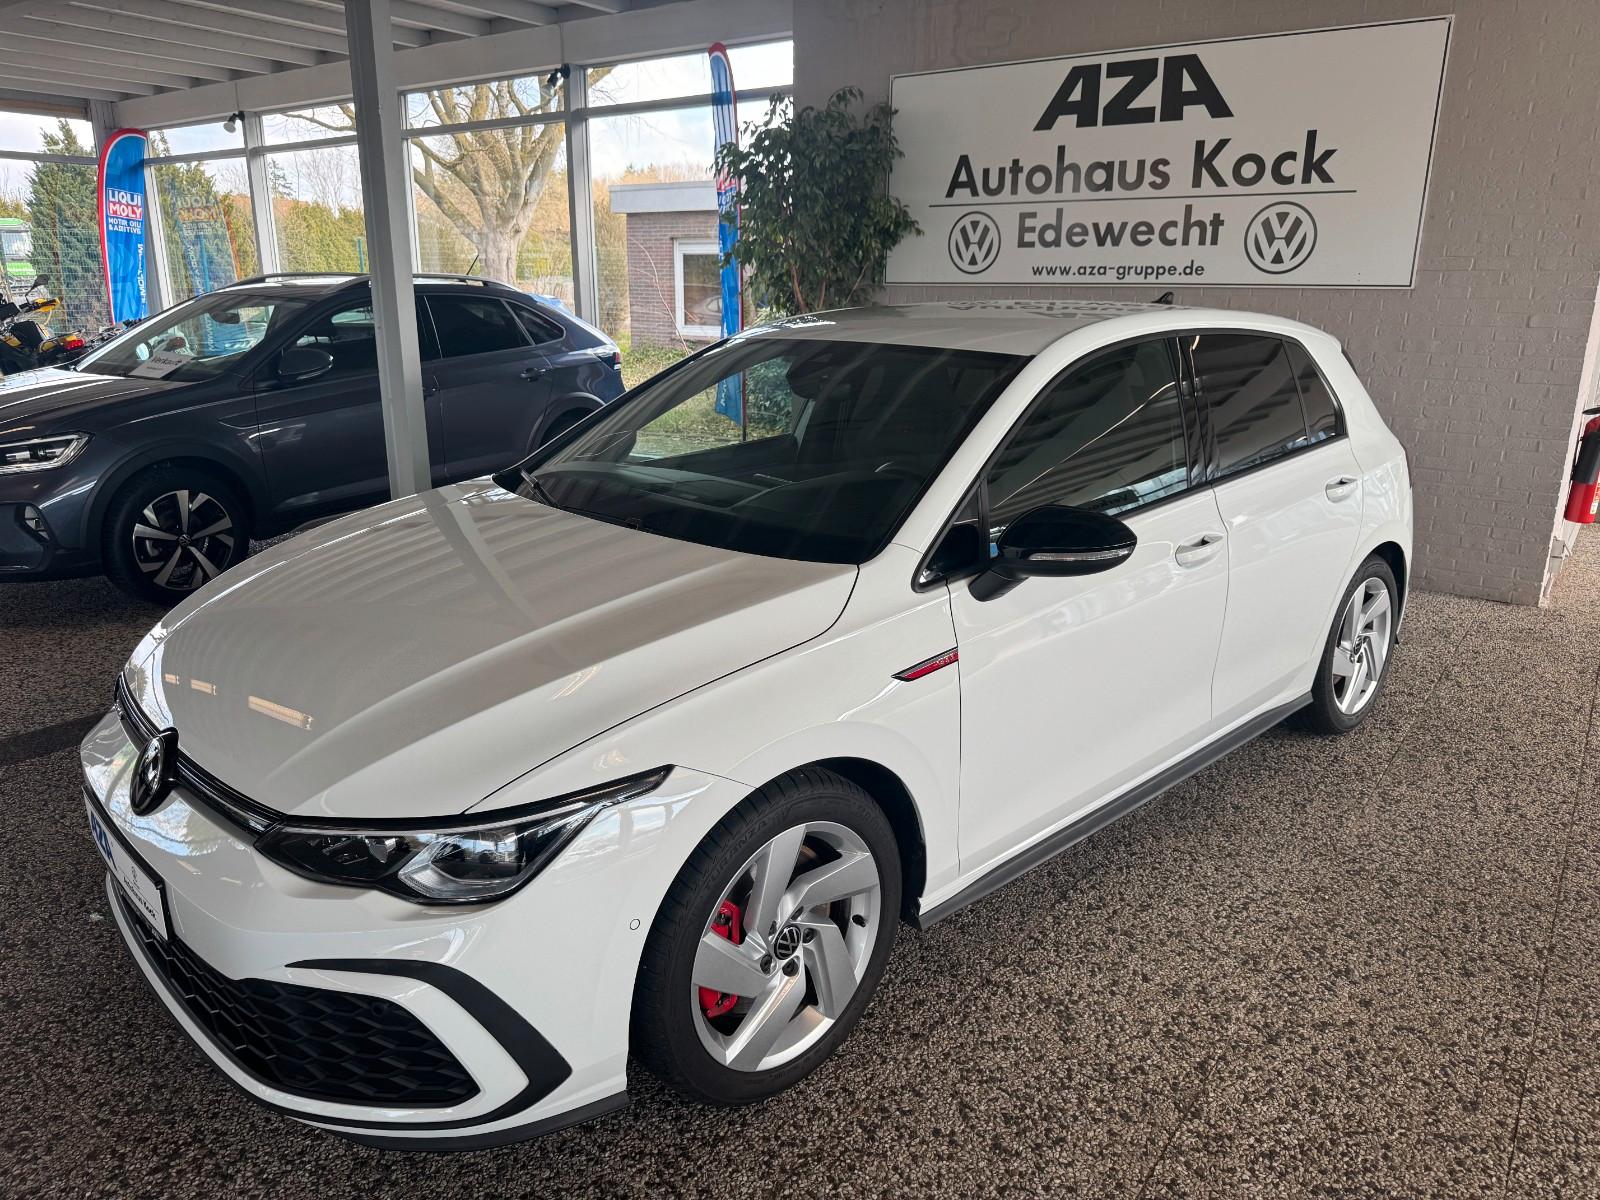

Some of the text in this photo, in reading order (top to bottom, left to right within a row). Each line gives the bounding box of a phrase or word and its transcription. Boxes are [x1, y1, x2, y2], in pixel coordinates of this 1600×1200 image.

[1033, 53, 1234, 131] AZA
[945, 130, 1338, 198] Autohaus Kock
[108, 189, 142, 206] LIQUI
[109, 202, 142, 219] MOLY
[1017, 204, 1225, 249] Edewecht
[1032, 260, 1205, 280] www.aza-gruppe.de
